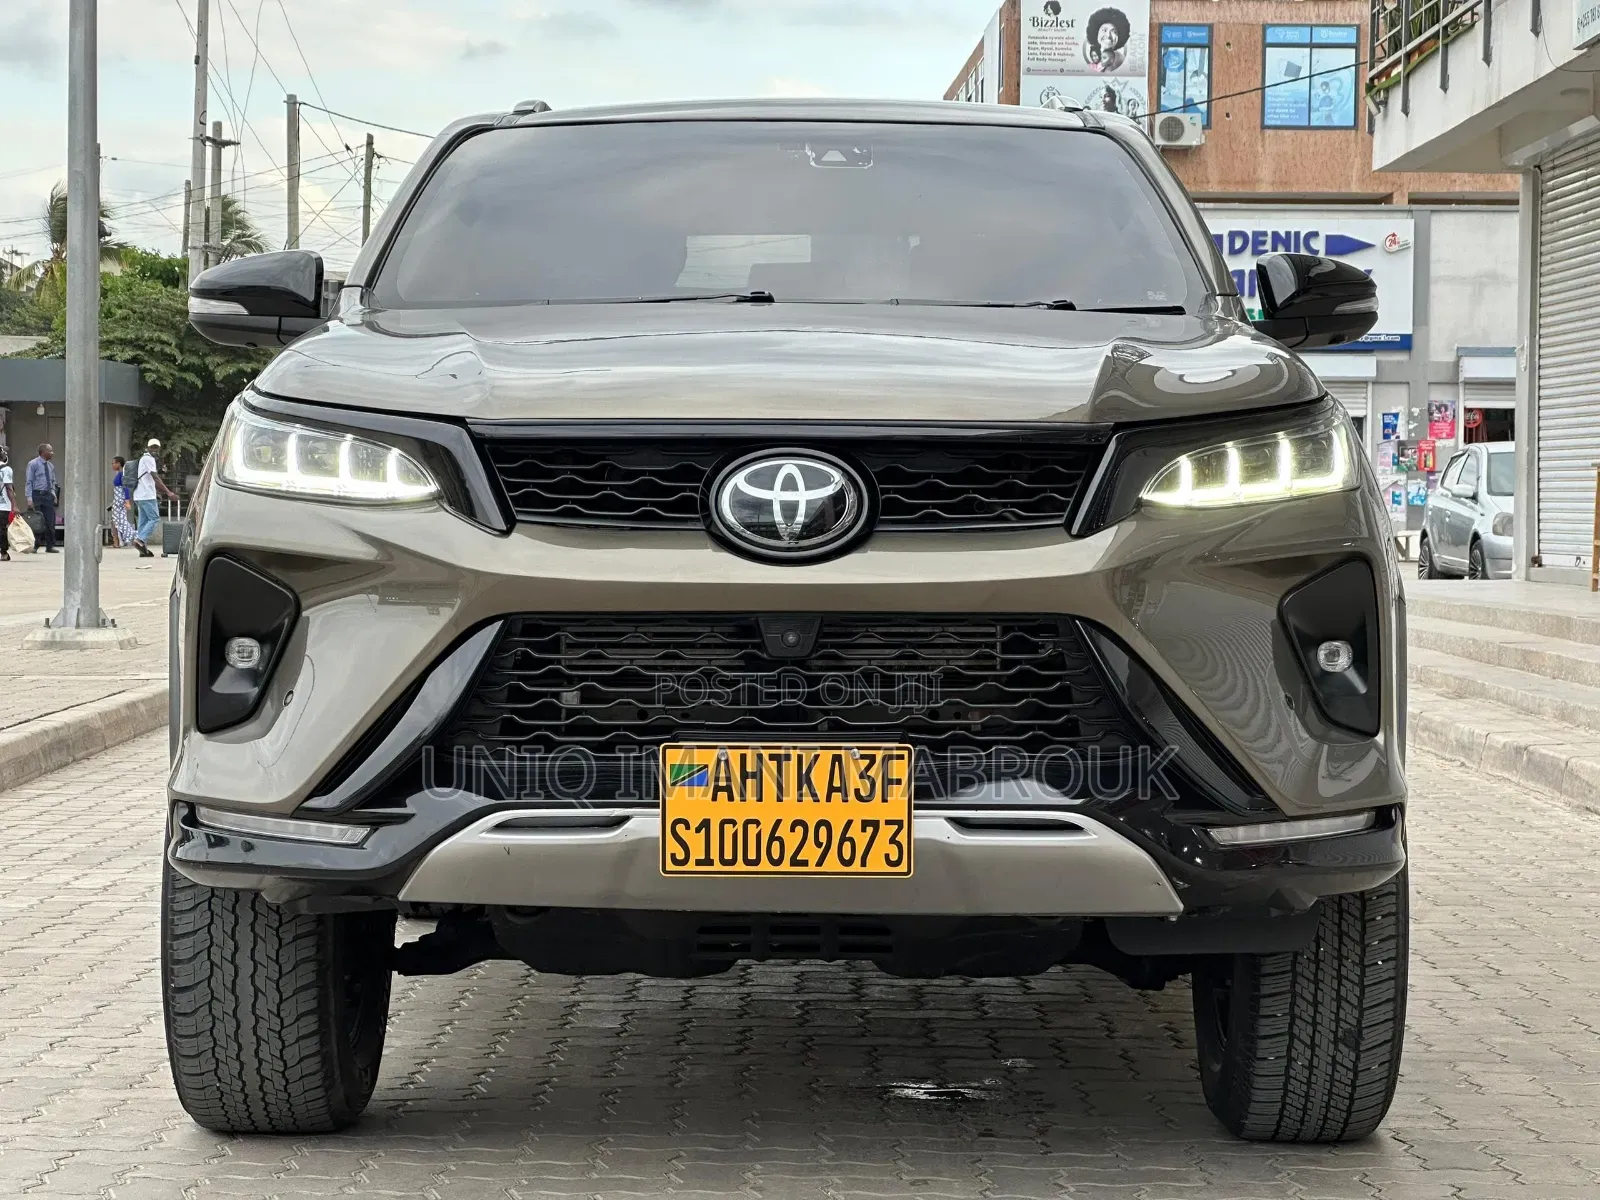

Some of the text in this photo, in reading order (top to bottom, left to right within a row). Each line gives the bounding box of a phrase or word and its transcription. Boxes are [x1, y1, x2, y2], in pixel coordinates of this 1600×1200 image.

[1029, 16, 1076, 28] Bizzlest
[1228, 230, 1320, 256] DENIC
[710, 752, 906, 803] AHTKA3F
[669, 817, 905, 868] S100629673
